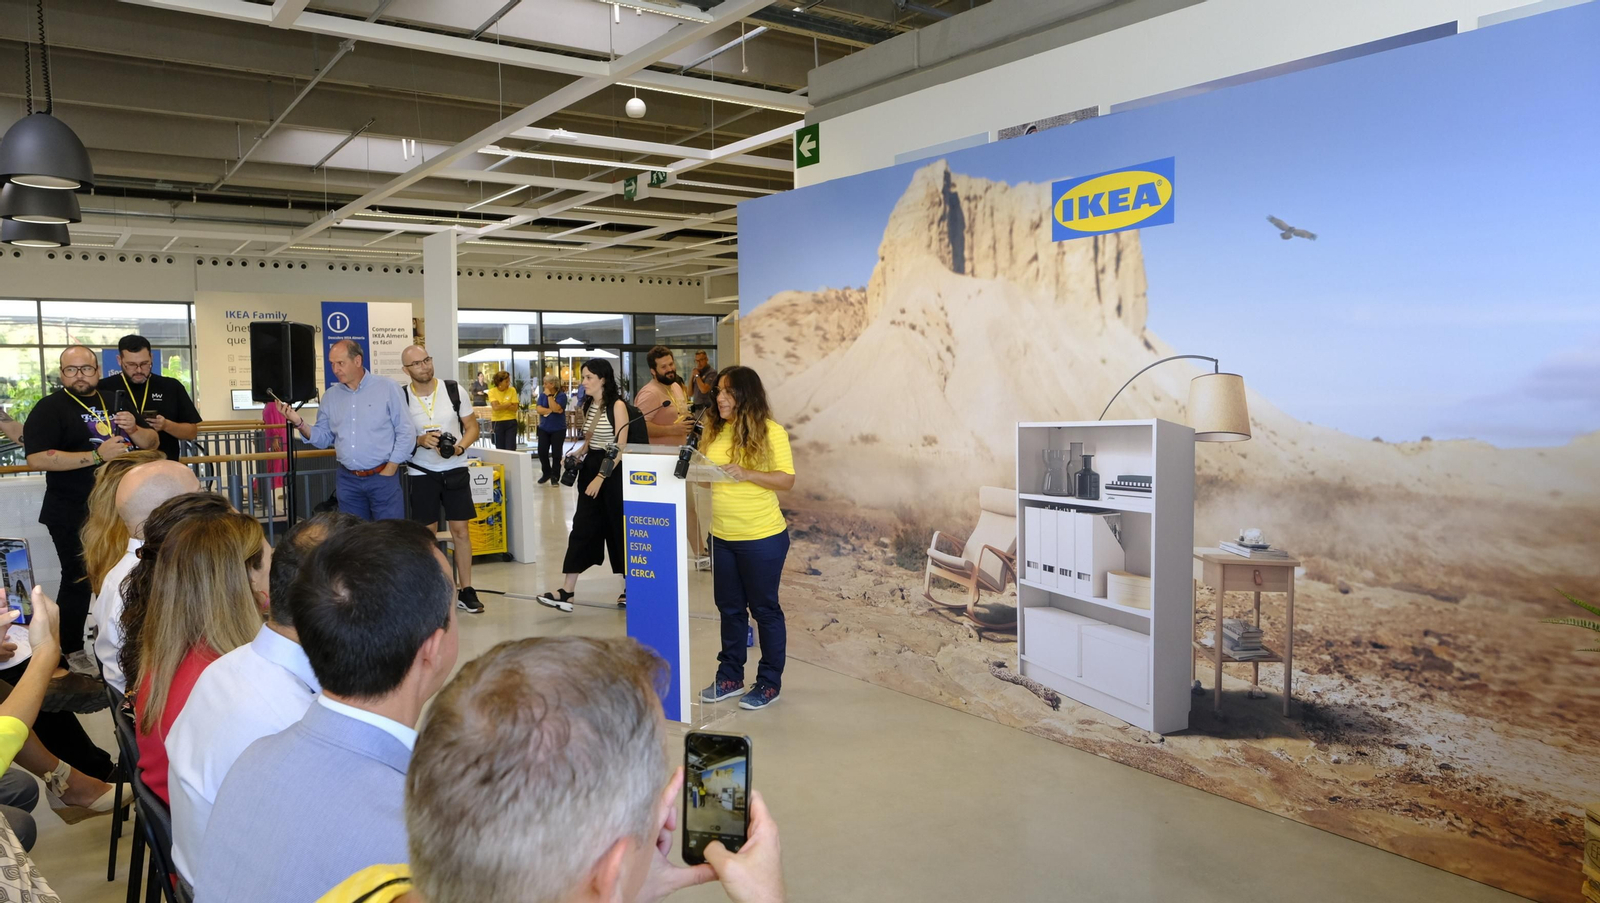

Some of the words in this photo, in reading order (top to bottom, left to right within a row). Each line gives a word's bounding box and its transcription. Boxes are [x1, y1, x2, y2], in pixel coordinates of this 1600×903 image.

[1062, 182, 1161, 222] IKEA
[225, 310, 250, 318] IKEA
[252, 311, 288, 322] Family
[226, 322, 250, 332] Únet
[226, 337, 246, 346] que
[629, 516, 670, 527] CRECEMOS
[630, 529, 649, 538] PARA
[630, 542, 652, 552] ESTAR
[630, 554, 648, 564] MÁS
[630, 568, 656, 579] CERCA
